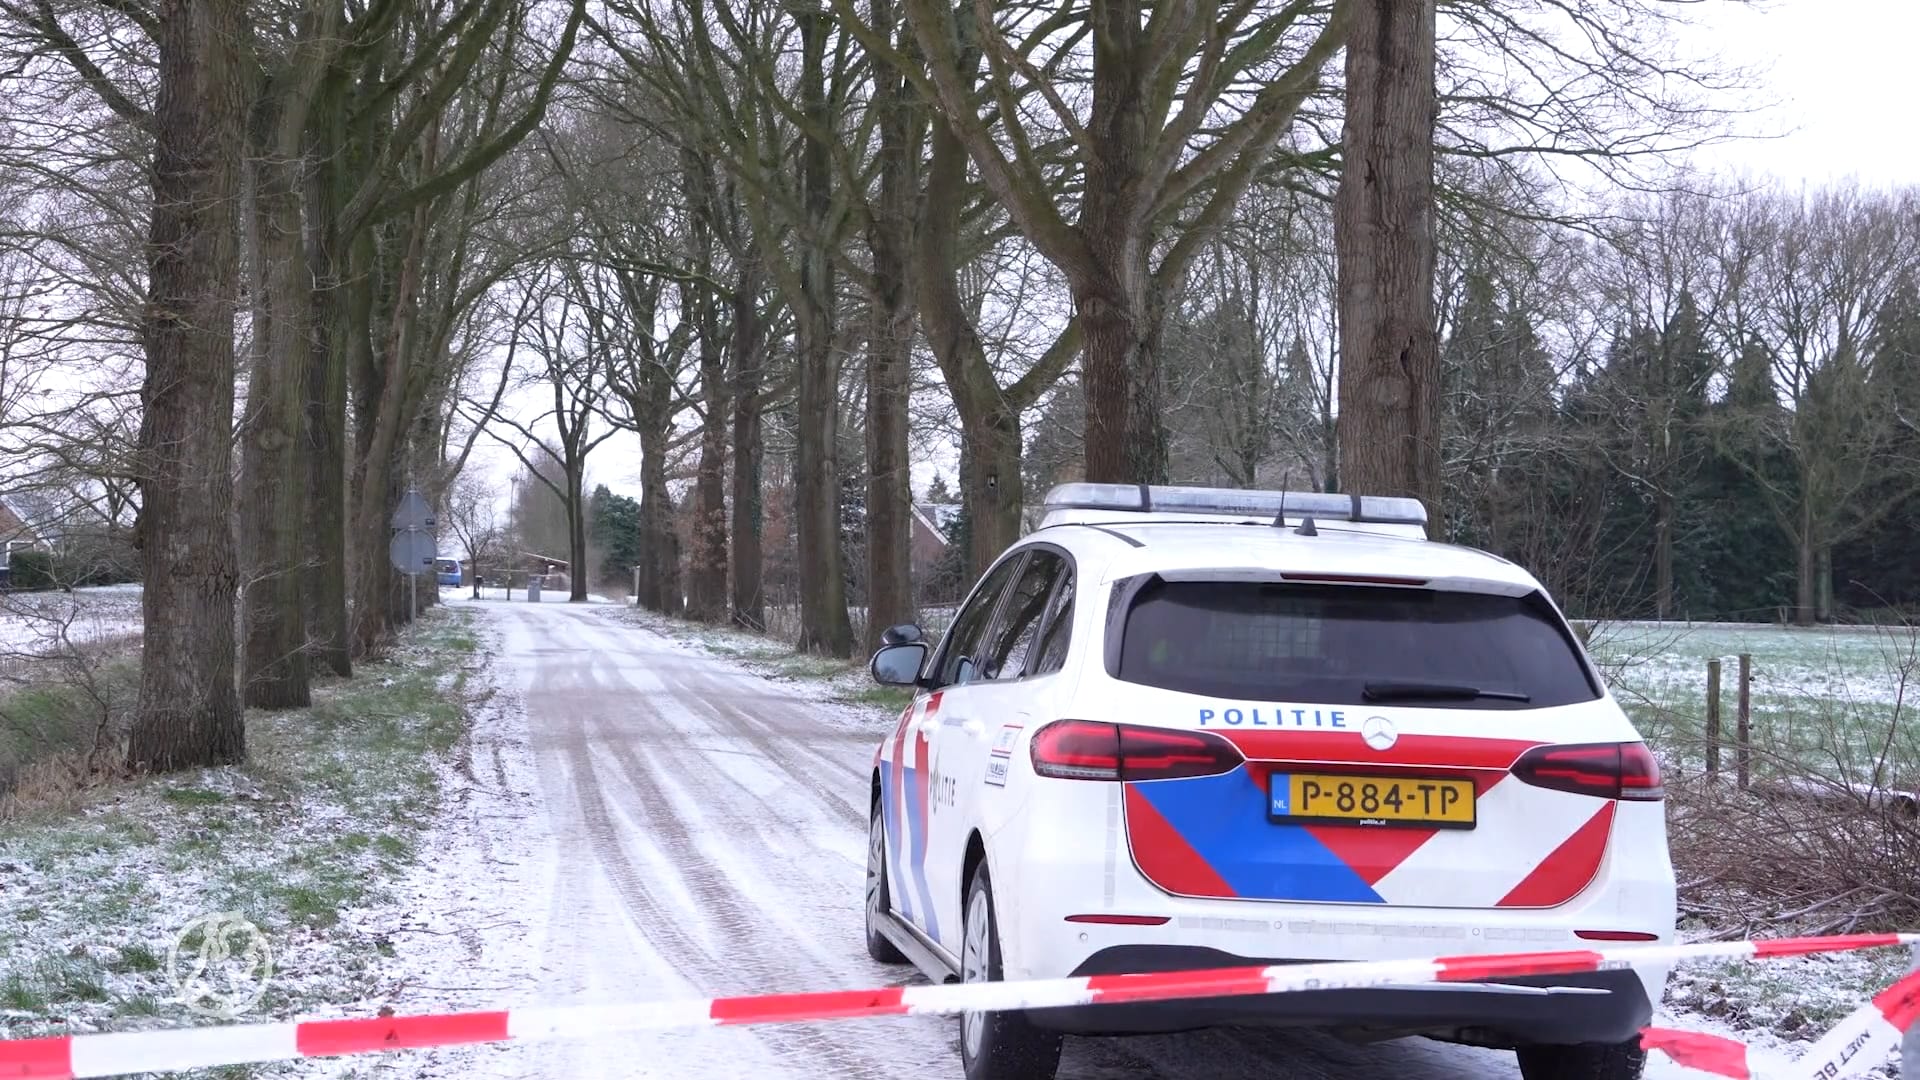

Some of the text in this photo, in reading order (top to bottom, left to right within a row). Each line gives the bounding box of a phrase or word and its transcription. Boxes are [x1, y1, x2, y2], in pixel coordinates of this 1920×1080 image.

[1199, 708, 1347, 728] POLITIE
[1273, 780, 1460, 815] NL P-884-TP
[1359, 818, 1386, 826] politie.nl
[1839, 1029, 1871, 1067] NIET
